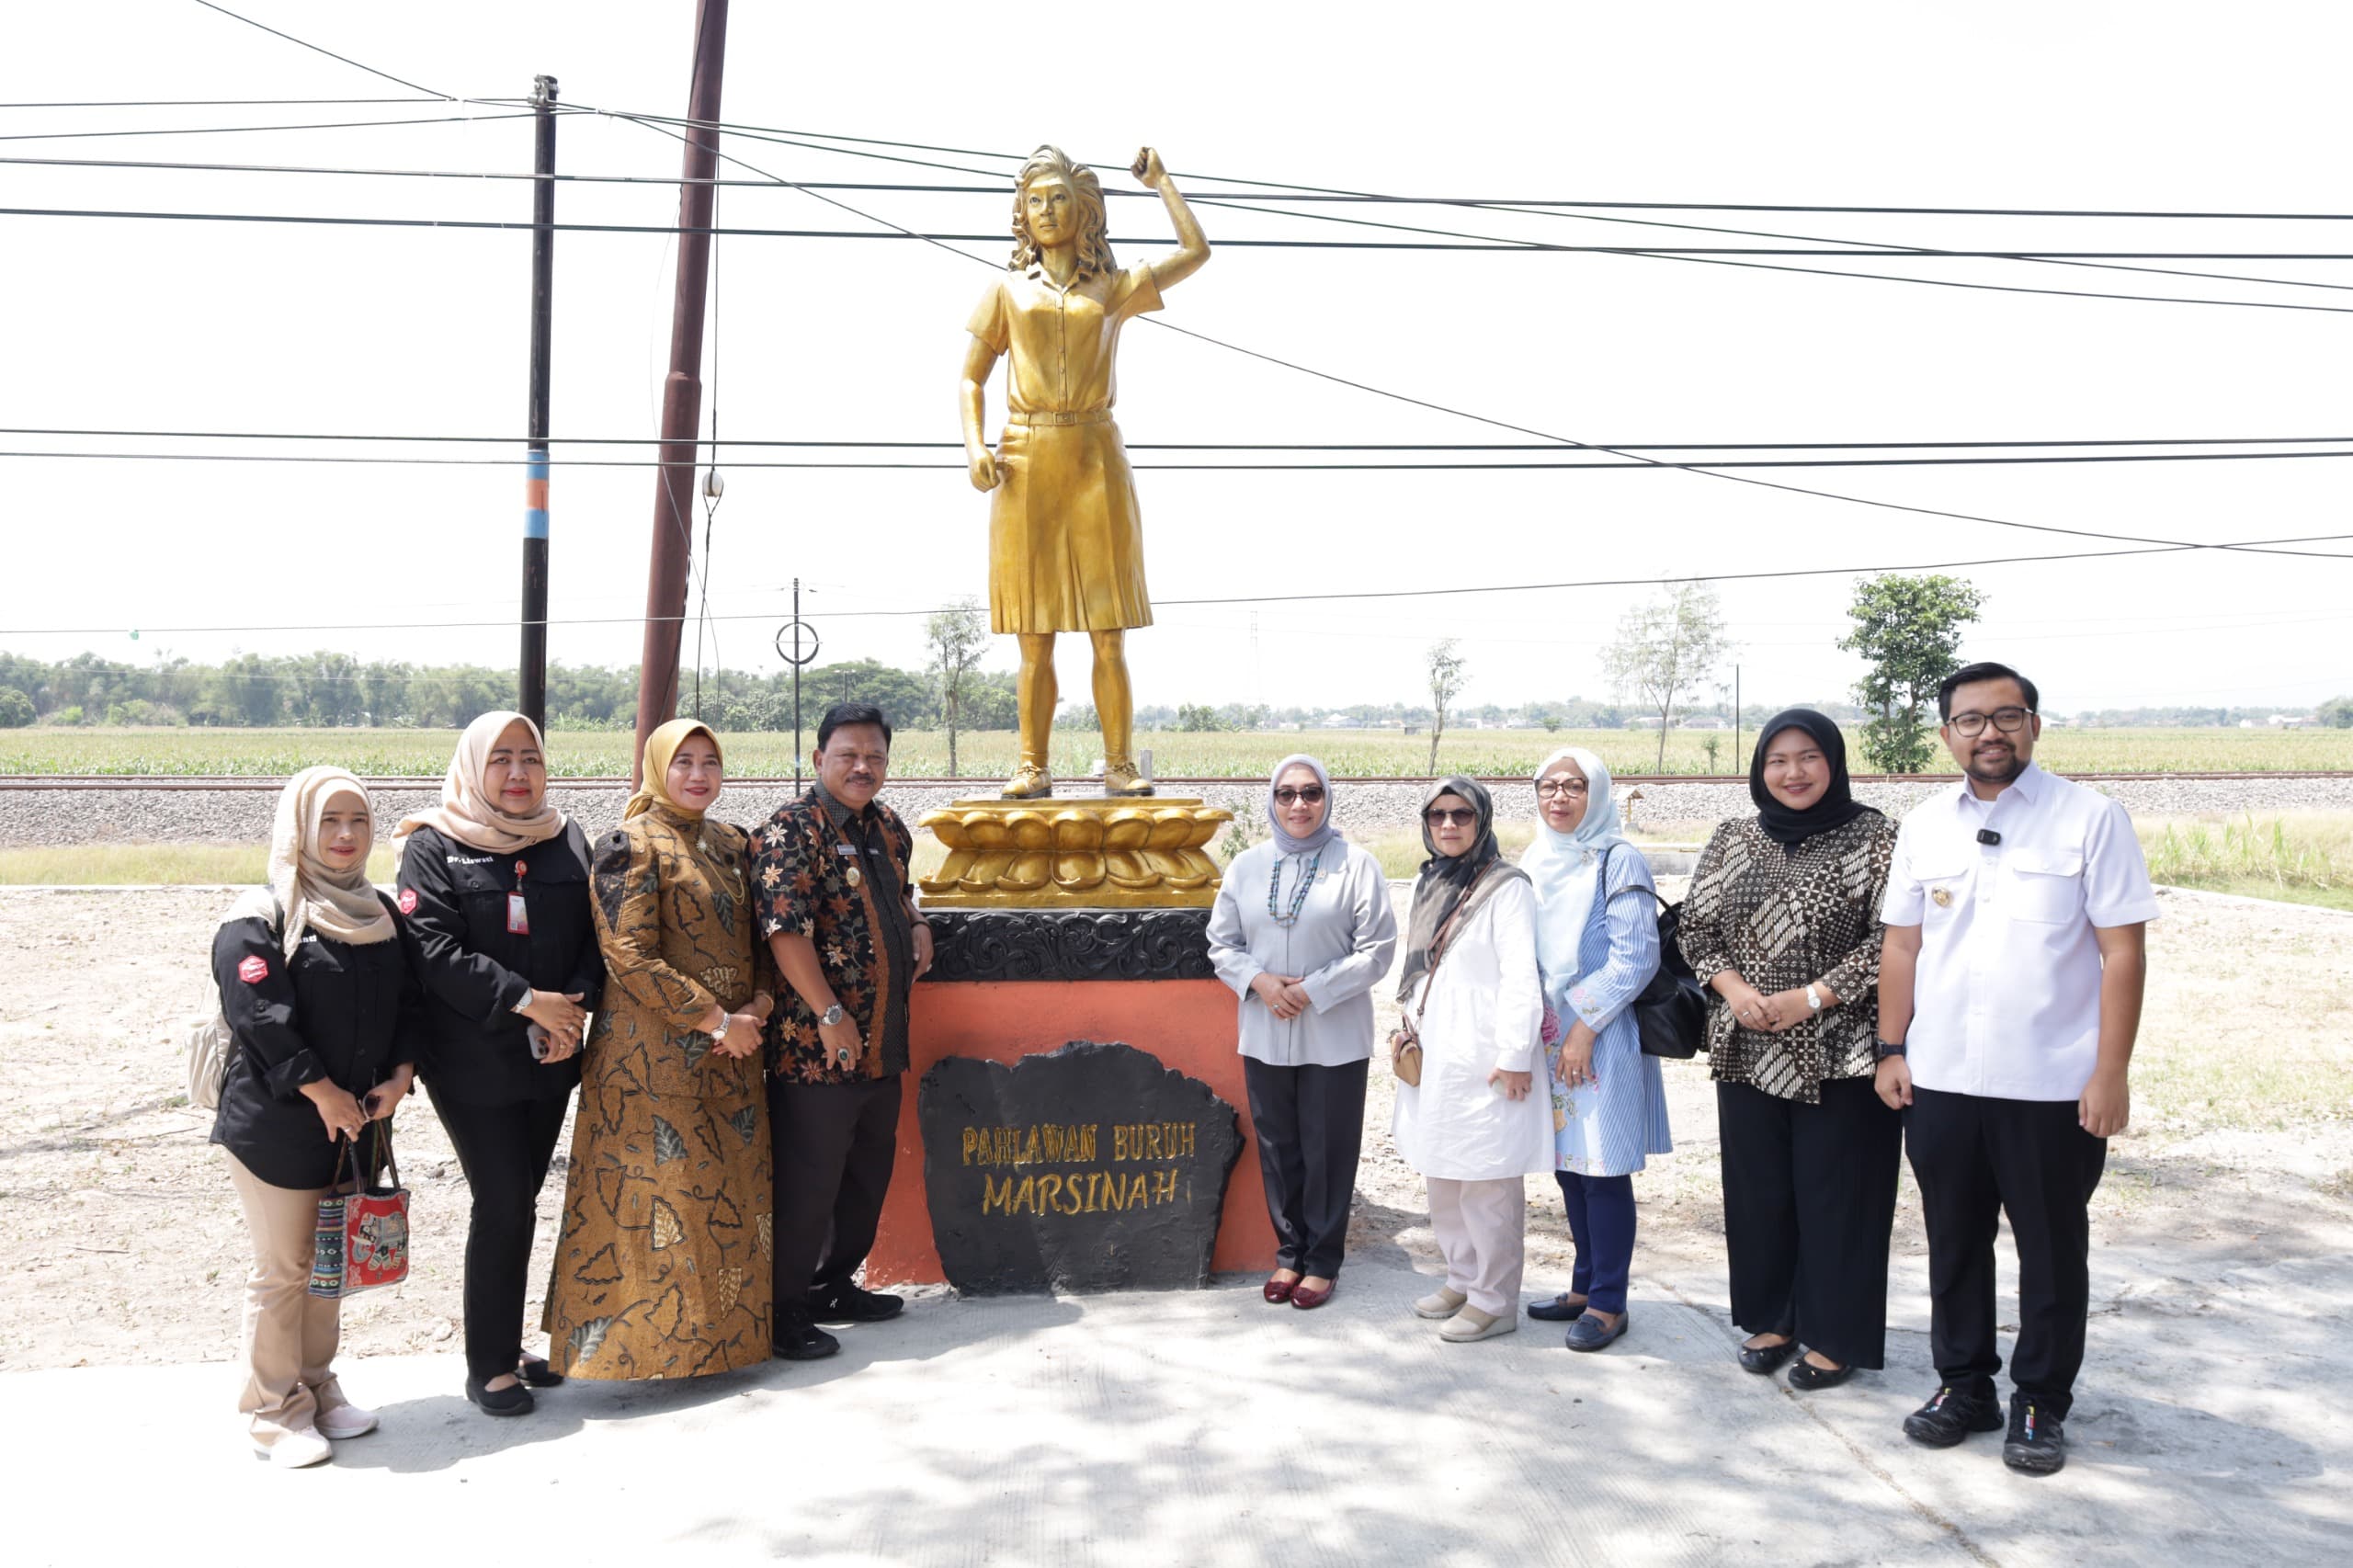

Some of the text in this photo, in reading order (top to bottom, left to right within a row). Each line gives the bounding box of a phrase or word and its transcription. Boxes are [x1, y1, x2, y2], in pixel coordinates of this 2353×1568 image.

[962, 1121, 1196, 1166] PAHLAWAN BURUH
[982, 1168, 1178, 1217] MARSINAH
